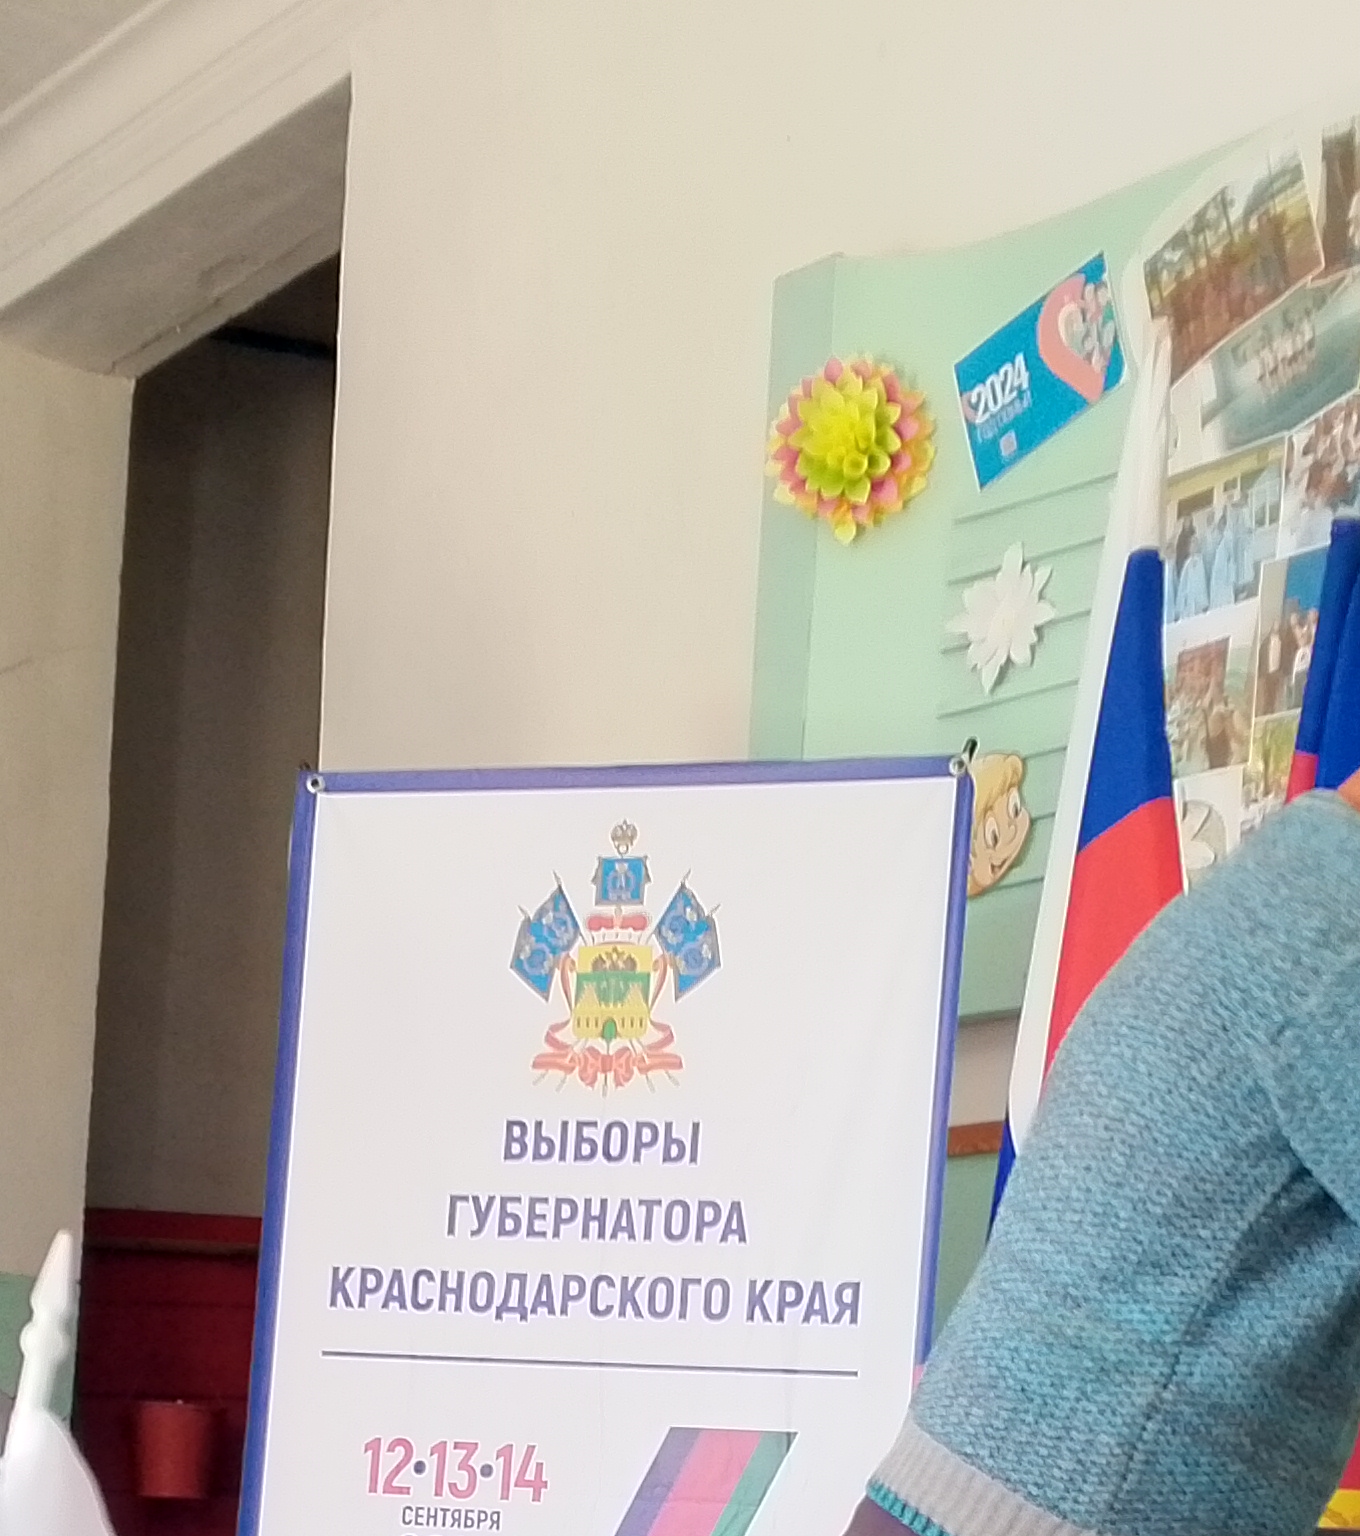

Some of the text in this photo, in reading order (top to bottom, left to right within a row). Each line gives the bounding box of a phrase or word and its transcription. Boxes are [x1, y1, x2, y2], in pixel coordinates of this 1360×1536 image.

[970, 351, 1030, 425] 2024
[501, 1118, 702, 1166] ВЫБОРЫ
[445, 1194, 749, 1245] ГУБЕРНАТОРА
[328, 1265, 863, 1327] КРАСНОДАРСКОГО КРАЯ
[401, 1505, 501, 1531] СЕНТЯБРЯ
